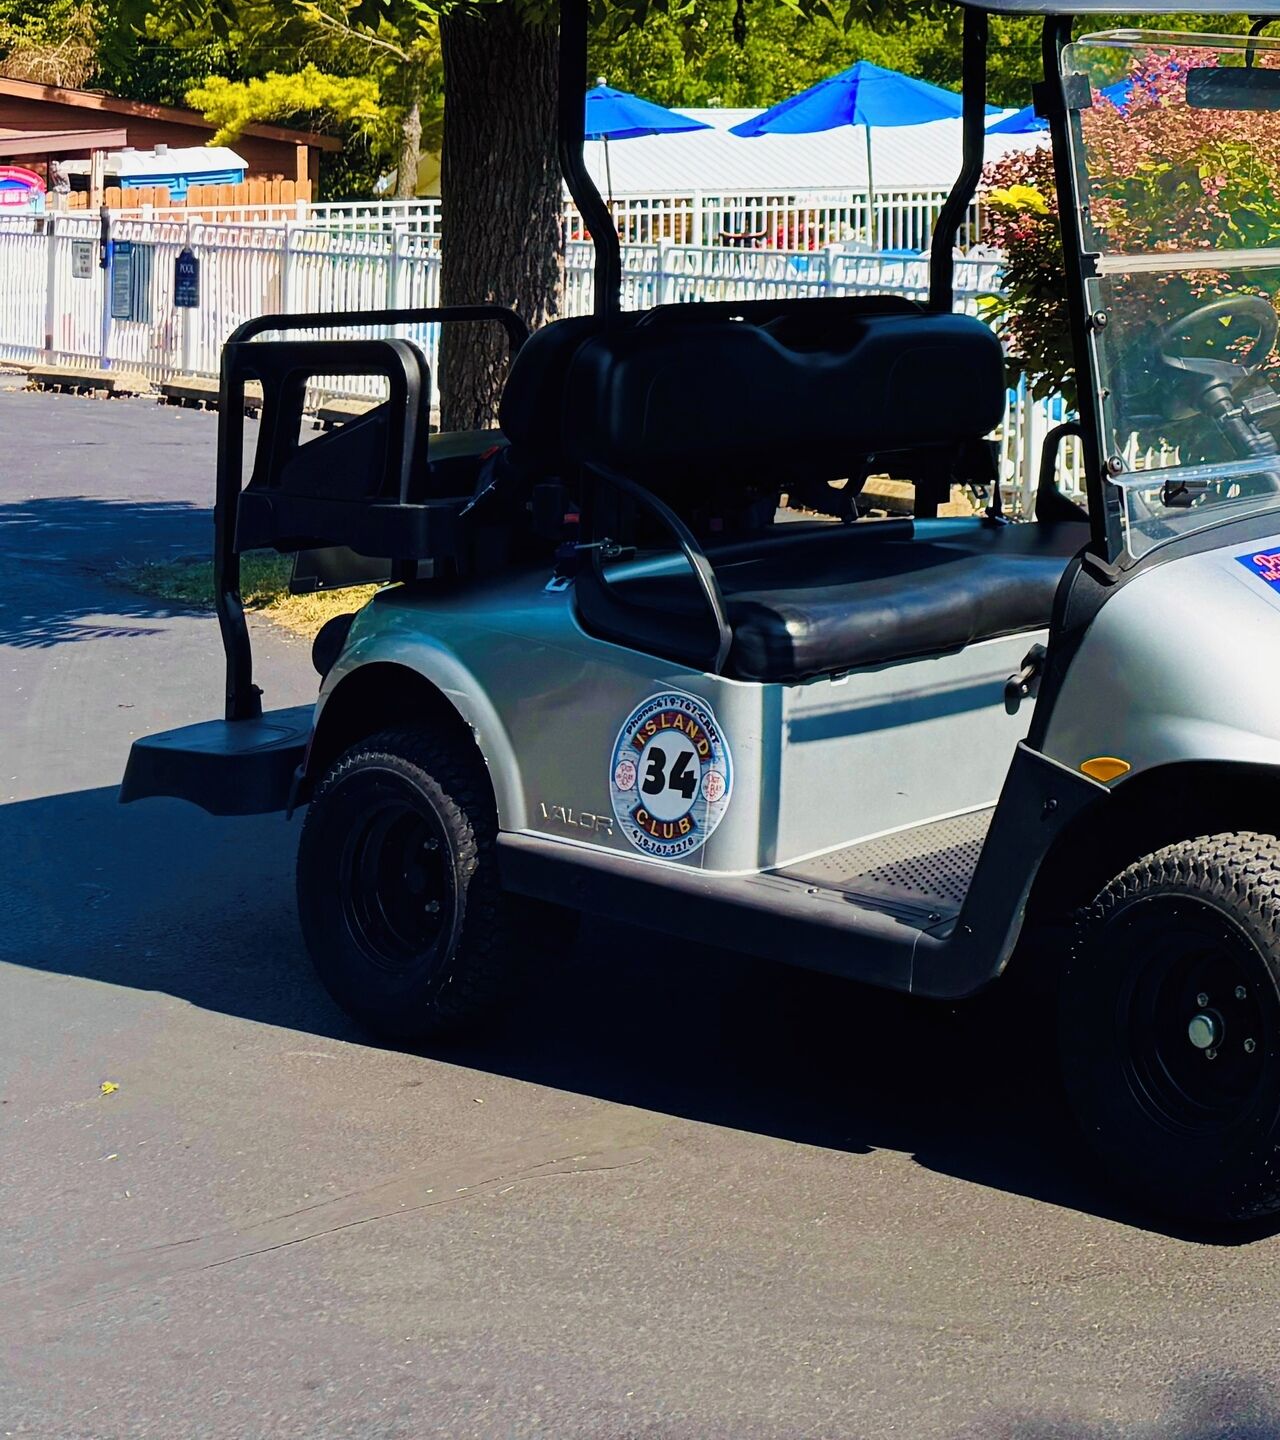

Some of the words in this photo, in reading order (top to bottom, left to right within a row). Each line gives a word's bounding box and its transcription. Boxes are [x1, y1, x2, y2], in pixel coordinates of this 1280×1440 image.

[636, 713, 709, 755] ISLAND
[642, 747, 698, 799] 34
[636, 809, 691, 838] CLUB
